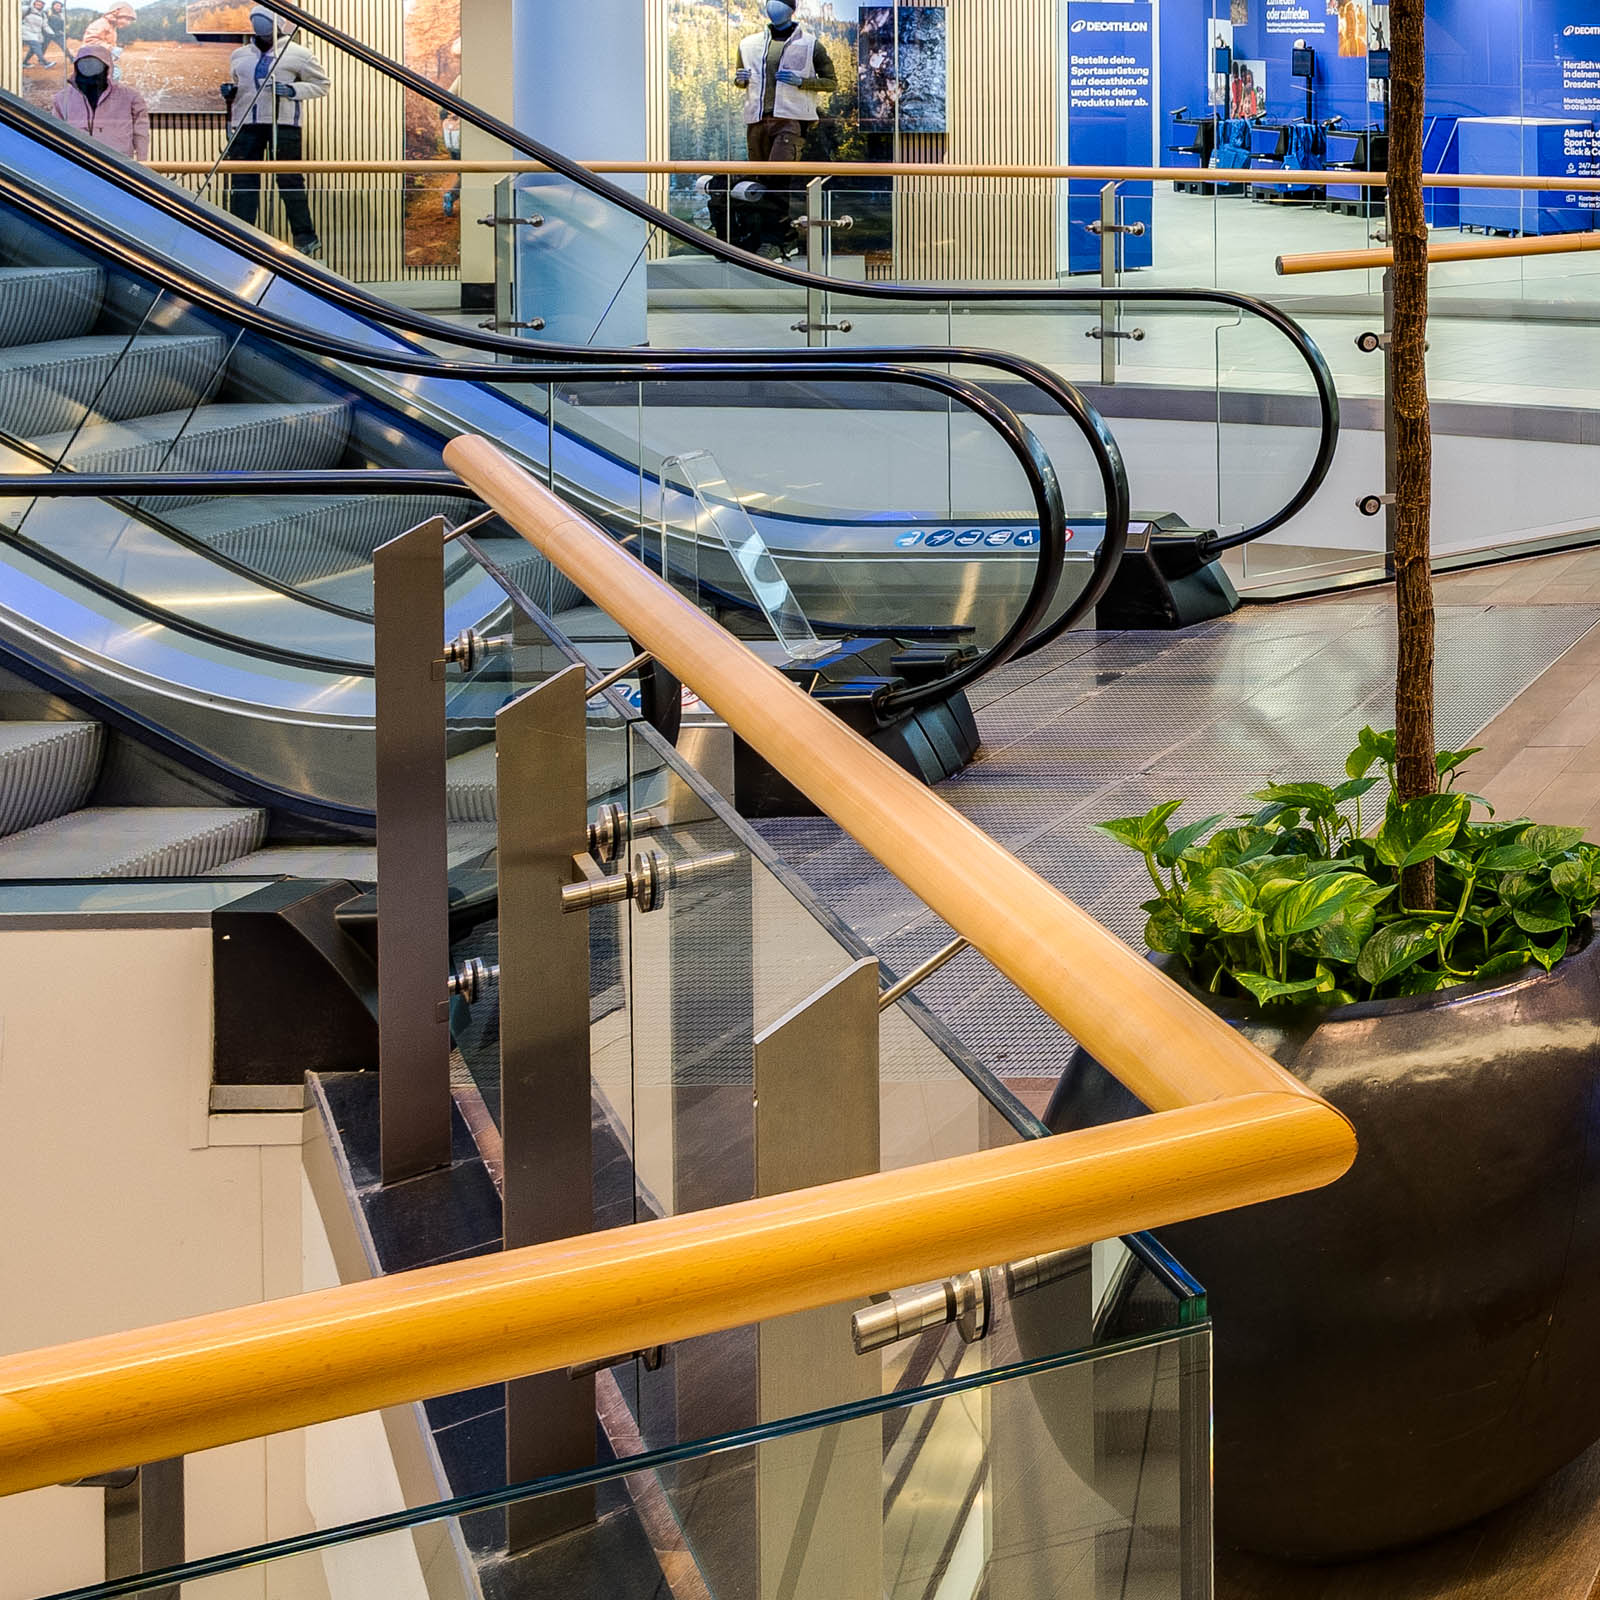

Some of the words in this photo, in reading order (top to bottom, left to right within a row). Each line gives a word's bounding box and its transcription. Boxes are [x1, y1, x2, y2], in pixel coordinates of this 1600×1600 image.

[1266, 7, 1280, 20] oder
[1280, 6, 1310, 20] zufrieden
[1086, 22, 1148, 31] DECATHLON
[1071, 55, 1108, 64] Bestelle
[1109, 55, 1135, 64] deine
[1563, 61, 1595, 69] Herzlich
[1071, 66, 1149, 76] Sportausrüstung
[1563, 70, 1571, 78] in
[1571, 70, 1599, 78] deinem
[1071, 77, 1087, 85] auf
[1087, 77, 1148, 86] decathlon.de
[1071, 88, 1089, 96] und
[1090, 88, 1110, 96] hole
[1111, 88, 1137, 96] deine
[1071, 98, 1114, 107] Produkte
[1115, 98, 1133, 106] hier
[1134, 98, 1149, 107] ab.
[1564, 129, 1583, 138] Alles
[1583, 129, 1595, 138] für
[1563, 138, 1586, 148] Sport
[1563, 148, 1583, 156] Click
[1584, 148, 1591, 156] &
